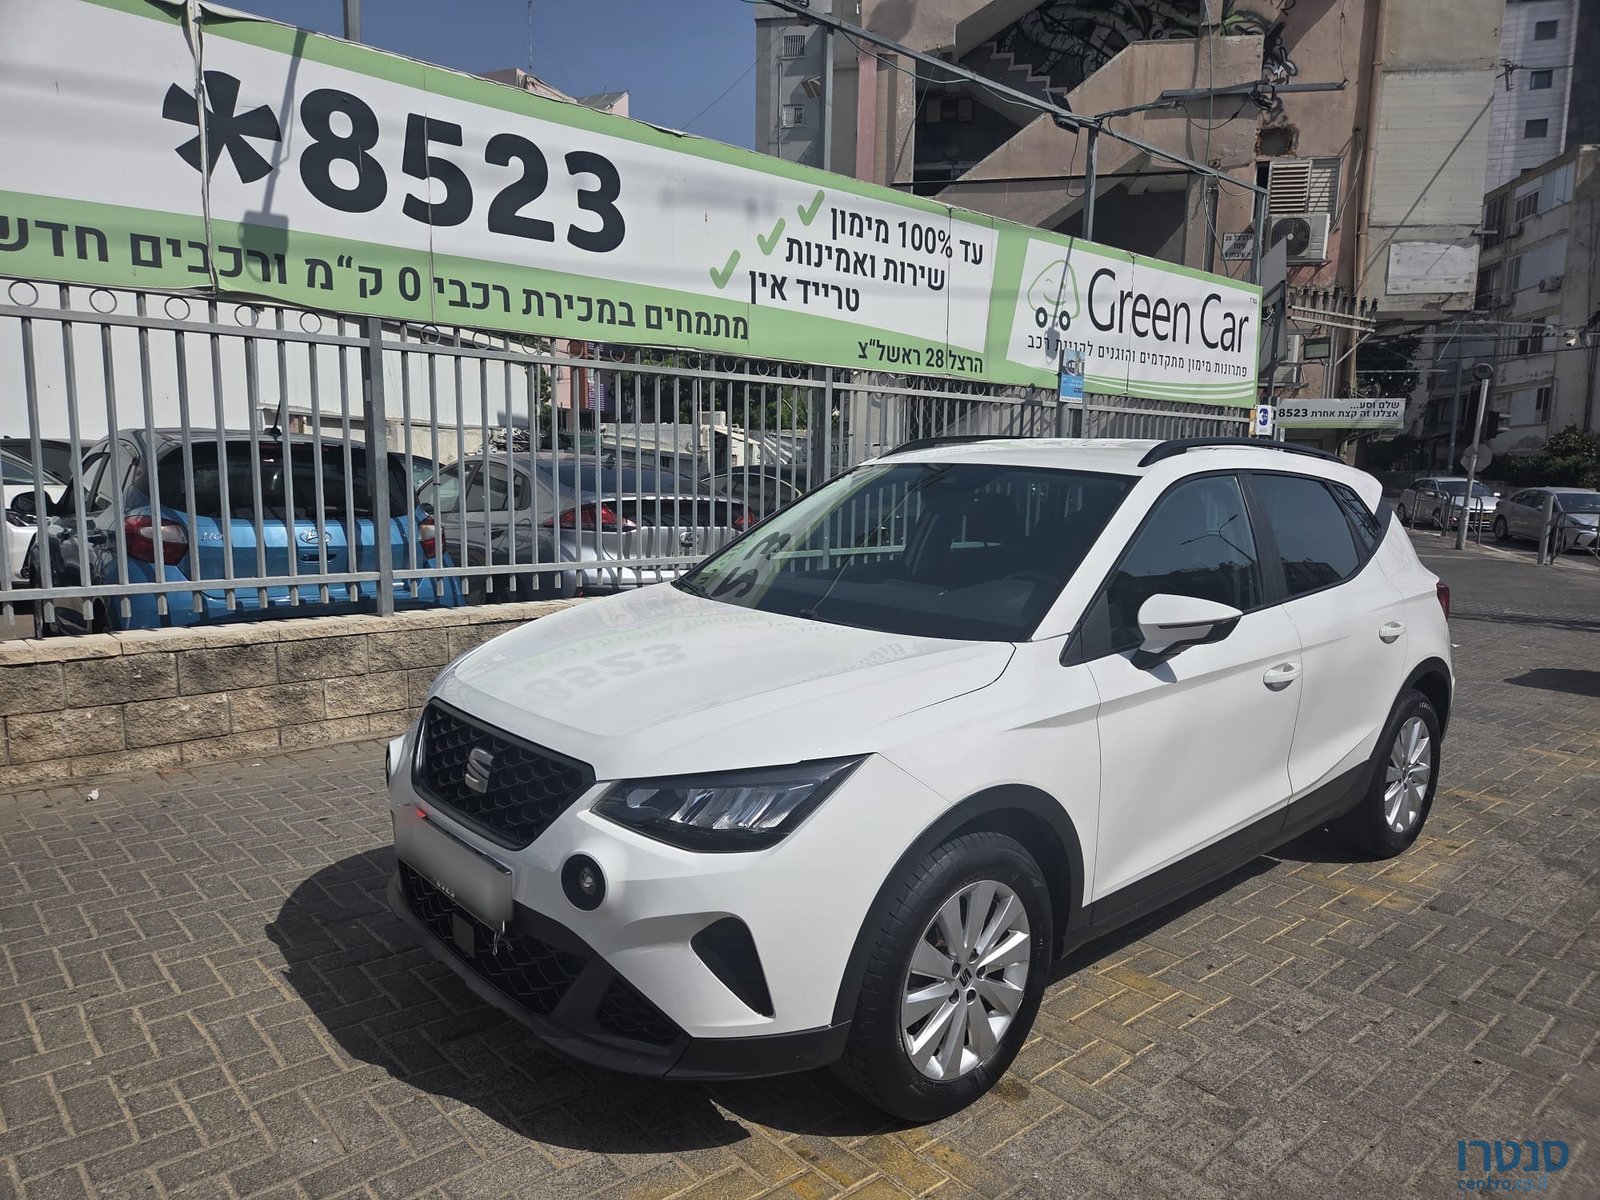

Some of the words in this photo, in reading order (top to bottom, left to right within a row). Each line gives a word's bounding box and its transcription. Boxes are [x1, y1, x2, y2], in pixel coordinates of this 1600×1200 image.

[831, 207, 889, 245] מימון
[898, 221, 953, 258] 100%
[130, 233, 287, 284] ורכבים
[785, 237, 876, 278] ואמינות
[959, 240, 983, 265] עד
[399, 266, 421, 301] 0
[882, 257, 945, 291] שירות
[433, 277, 511, 312] רכבי
[749, 270, 787, 304] אין
[796, 278, 860, 312] טרייד
[522, 288, 636, 327] במכירת
[1087, 267, 1190, 344] Green
[1200, 293, 1249, 353] Car
[645, 304, 749, 340] מתמחים
[1028, 335, 1050, 351] רכב
[1098, 345, 1135, 362] והוגנים
[925, 347, 944, 368] 28
[949, 350, 983, 374] הרצל
[1140, 351, 1184, 370] מתקדמים
[1188, 358, 1211, 373] מימון
[1214, 362, 1247, 377] פתרונות
[1278, 408, 1308, 418] 8523
[1310, 410, 1335, 418] אחרת
[1337, 410, 1357, 419] קצת
[1373, 410, 1399, 418] אצלנו
[1377, 400, 1400, 409] שלם
